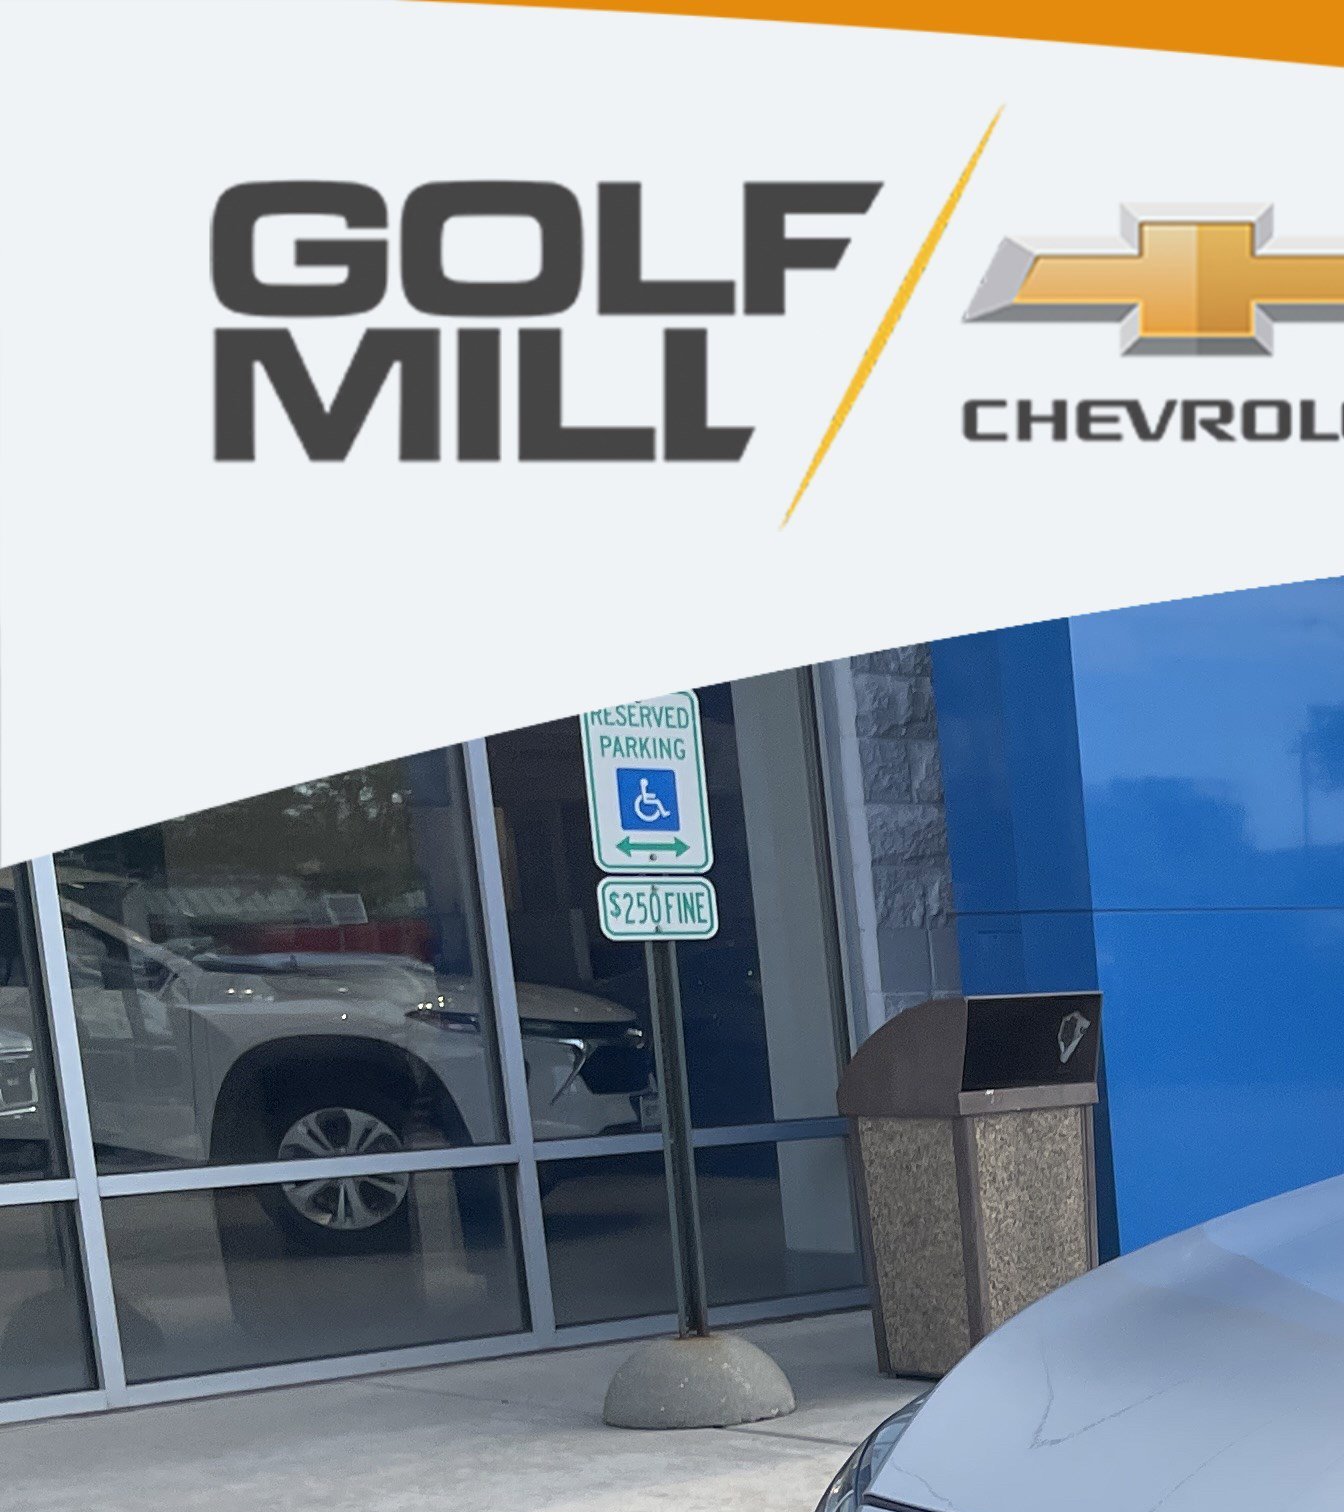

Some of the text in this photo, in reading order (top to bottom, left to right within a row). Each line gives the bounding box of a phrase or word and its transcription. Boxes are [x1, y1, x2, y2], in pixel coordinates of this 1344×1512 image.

[591, 704, 690, 730] RESERVED
[599, 735, 687, 761] PARKING
[609, 891, 709, 925] $250 FINE
